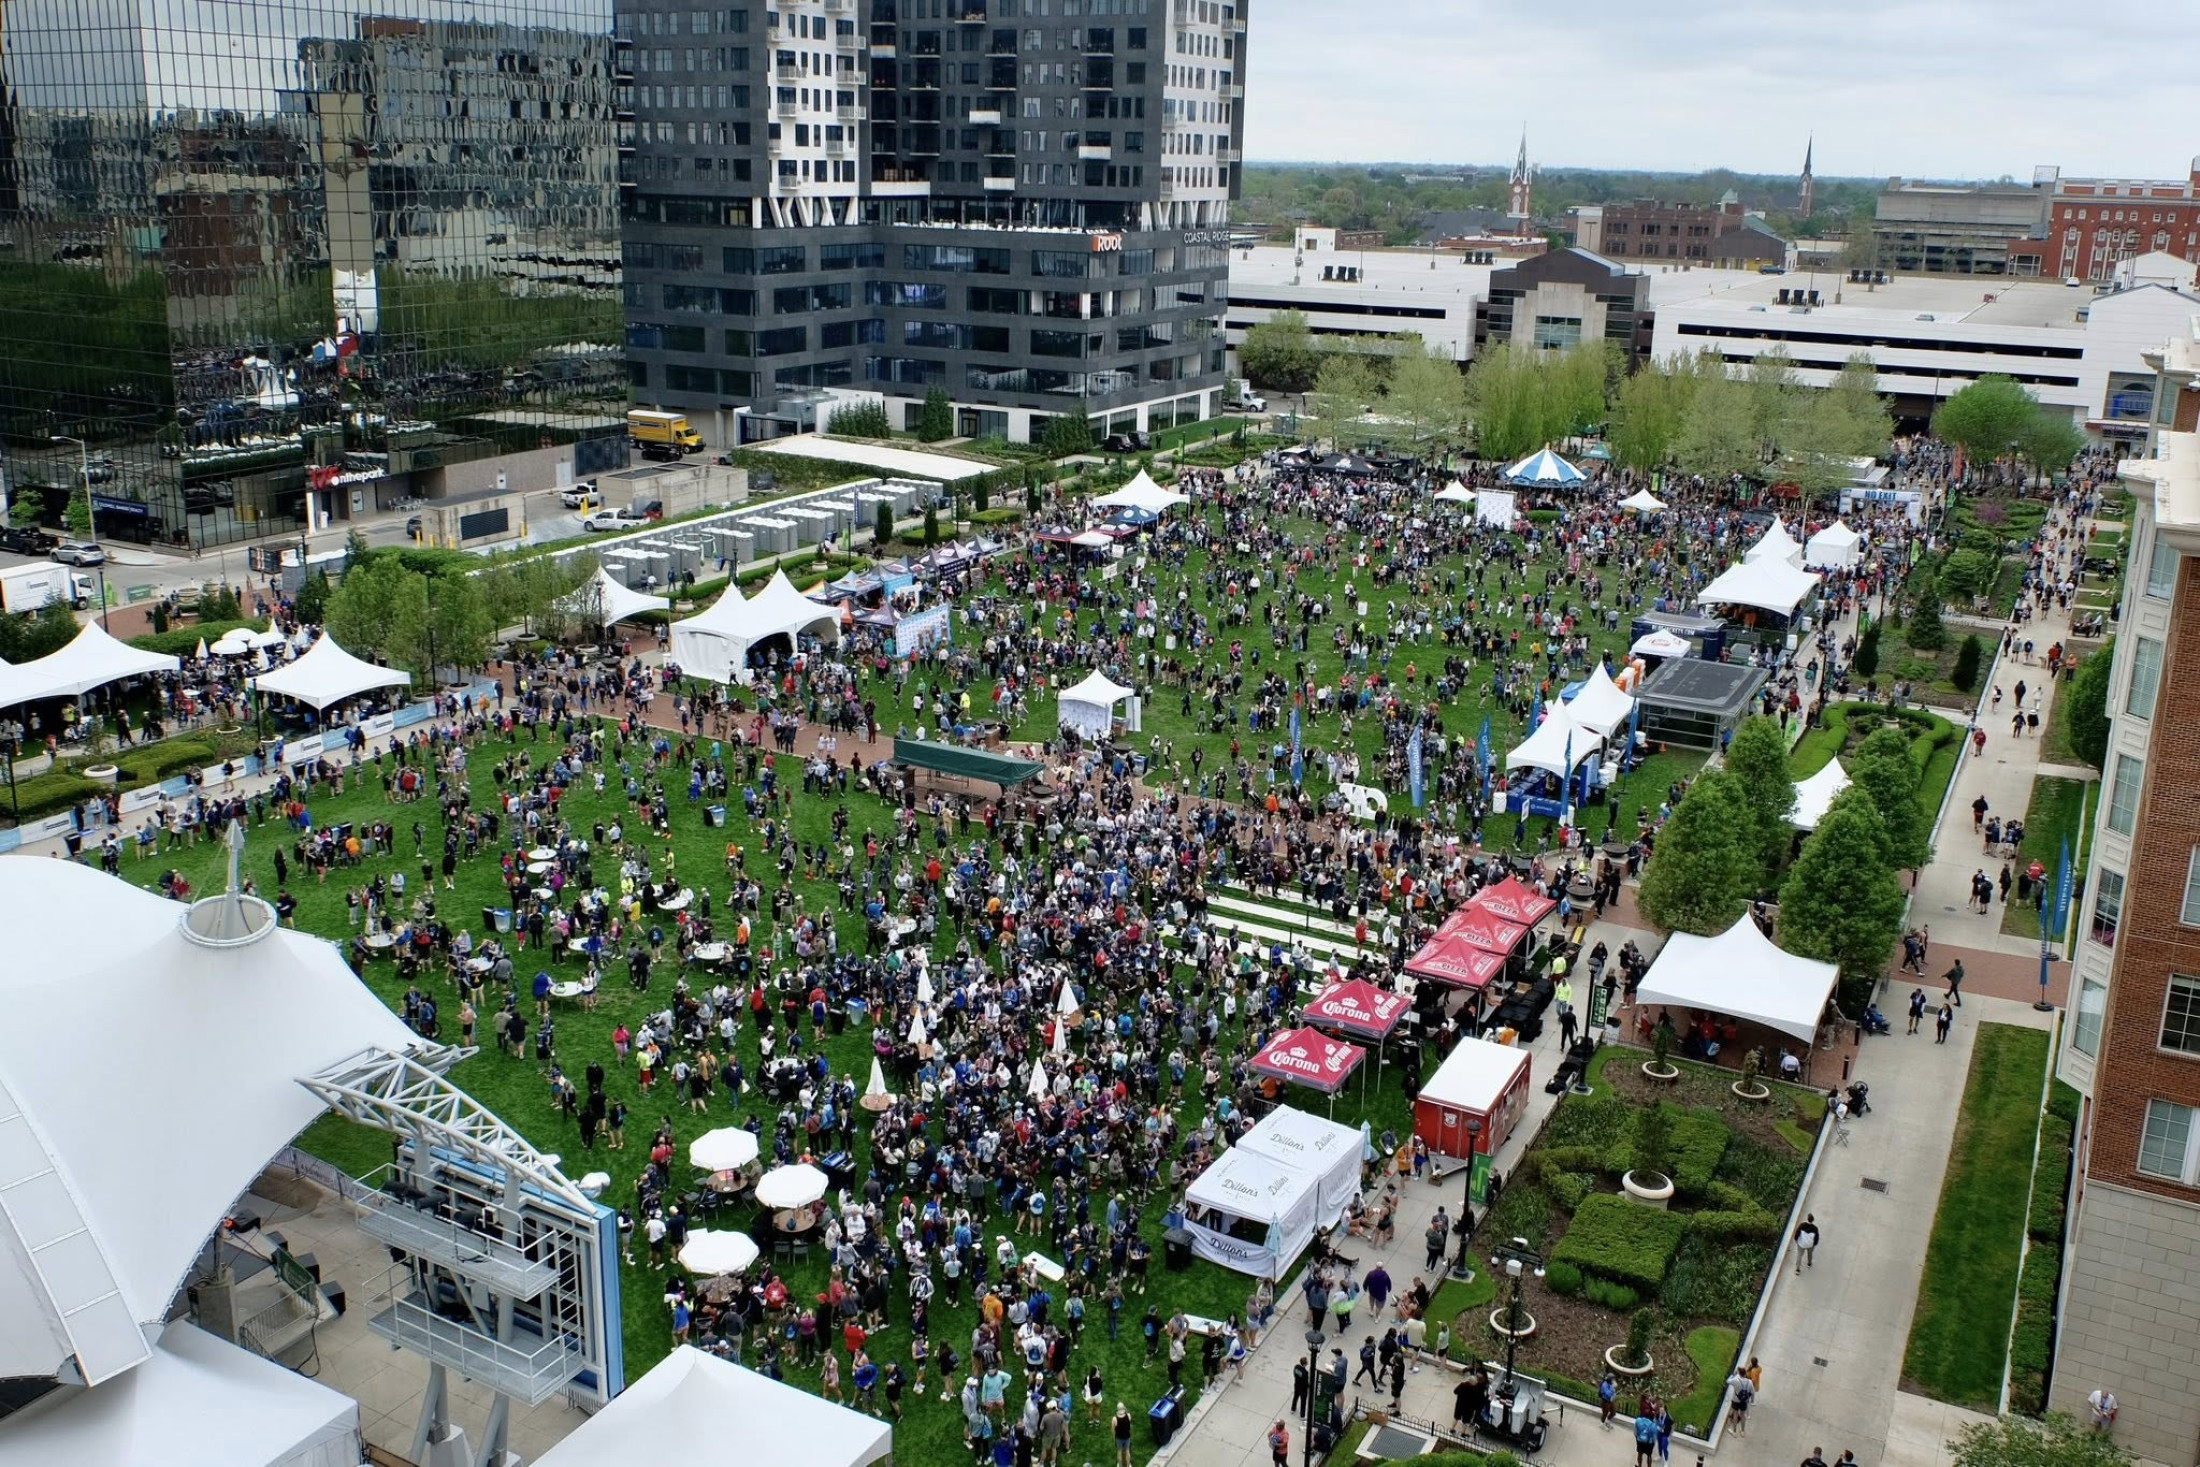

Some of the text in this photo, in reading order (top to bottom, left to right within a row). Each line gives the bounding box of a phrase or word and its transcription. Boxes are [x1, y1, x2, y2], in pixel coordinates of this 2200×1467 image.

[1184, 231, 1230, 244] COASTAL RIDGE
[1865, 490, 1896, 500] NO EXIT
[1494, 904, 1517, 914] PIZZA
[1467, 932, 1491, 944] PIZZA
[1442, 963, 1467, 974] PIZZA
[1322, 1001, 1371, 1022] Corona
[1269, 1051, 1320, 1073] Corona
[1270, 1133, 1305, 1151] Dillon's
[1221, 1178, 1258, 1197] Dillon's
[1210, 1237, 1248, 1259] Dillon's
